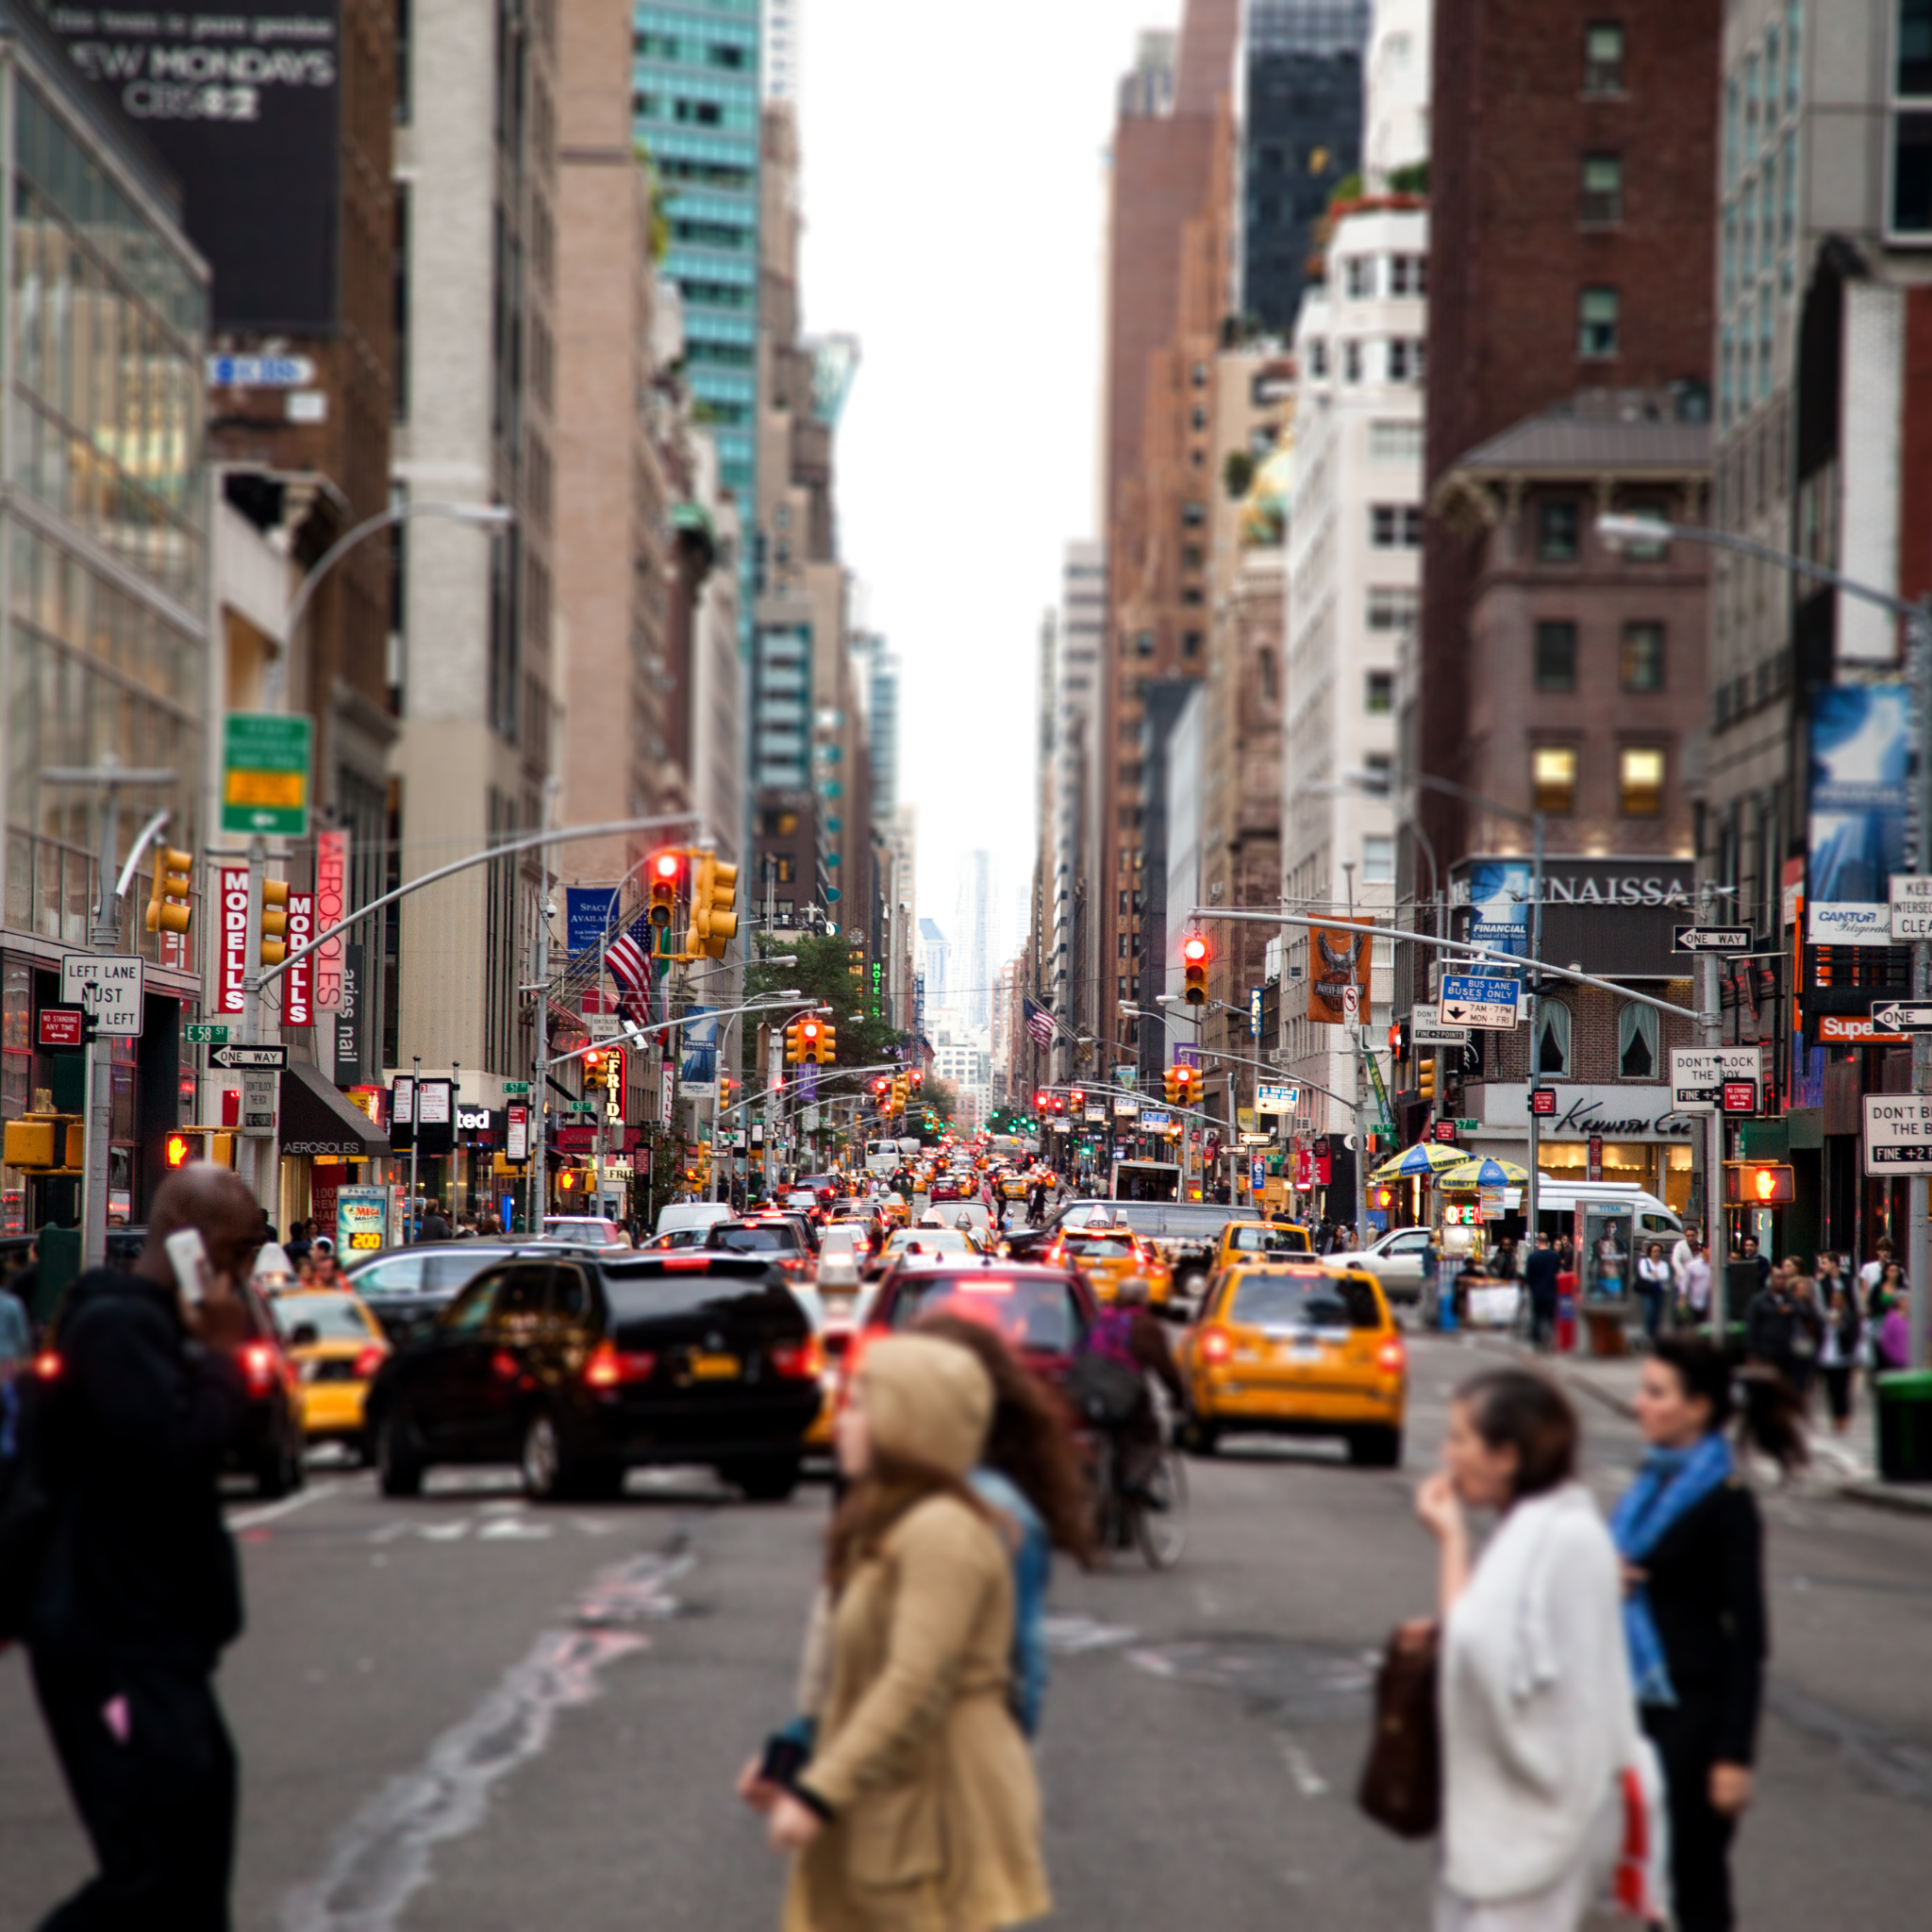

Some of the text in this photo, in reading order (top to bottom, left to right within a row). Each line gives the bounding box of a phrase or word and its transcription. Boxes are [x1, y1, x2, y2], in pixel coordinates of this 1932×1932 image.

[150, 45, 335, 86] MONDAYS
[580, 904, 607, 912] SPACE
[1819, 911, 1876, 923] CANTOR
[1474, 924, 1525, 933] FINANCIAL
[225, 873, 248, 1009] MODELLS
[1687, 934, 1741, 944] ONE WAY
[70, 966, 136, 979] LEFT LANE
[1469, 980, 1484, 989] BUS
[1448, 988, 1481, 997] BUSES
[107, 1013, 135, 1024] LEFT
[1471, 1014, 1487, 1023] MON
[1883, 1011, 1915, 1024] ONE
[187, 1026, 193, 1041] E
[198, 1027, 211, 1041] 58
[339, 1025, 358, 1062] nail
[220, 1052, 277, 1062] ONE WAY
[1678, 1058, 1754, 1067] DON'T LOCK
[1692, 1071, 1714, 1080] THE
[510, 1084, 519, 1092] 57
[1680, 1091, 1700, 1100] FINE
[457, 1108, 490, 1129] ted
[1873, 1107, 1915, 1119] DON'T
[1891, 1124, 1920, 1135] THE
[283, 1142, 359, 1154] AEROSOLES
[1876, 1147, 1924, 1160] FINE +2
[356, 1207, 380, 1216] MEGA
[1446, 1206, 1484, 1224] OPEN
[352, 1233, 381, 1249] 200
